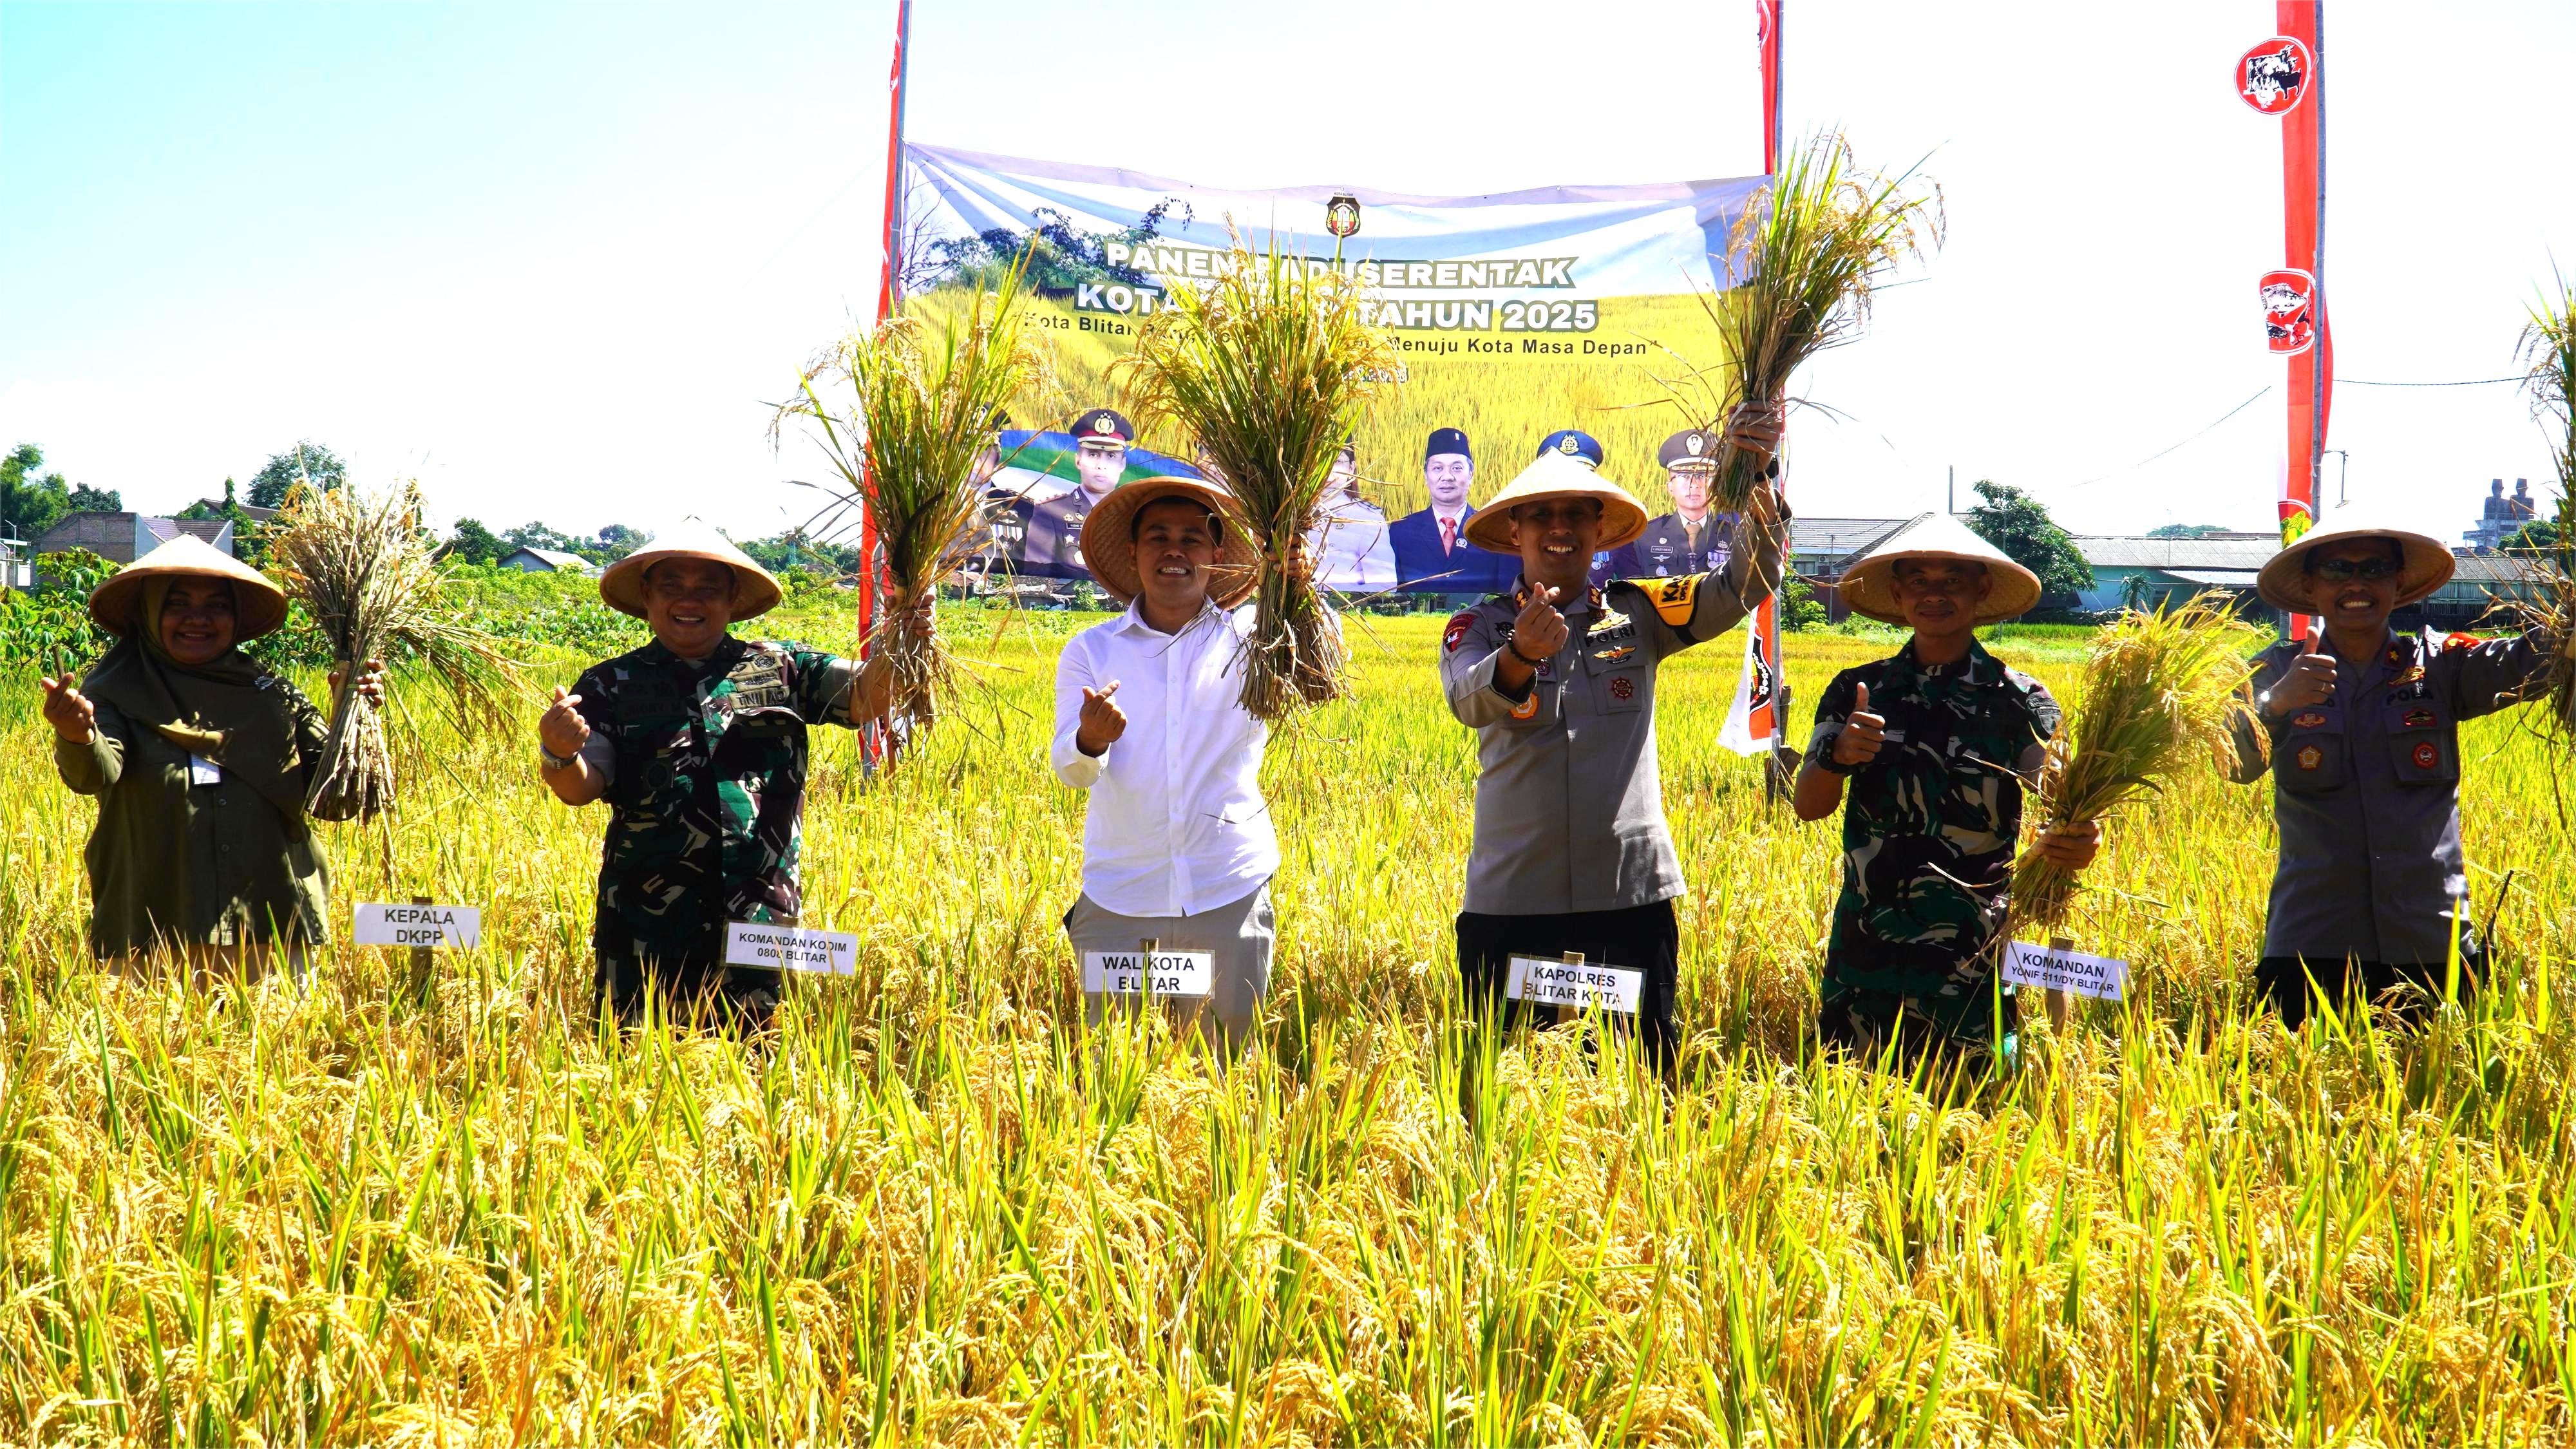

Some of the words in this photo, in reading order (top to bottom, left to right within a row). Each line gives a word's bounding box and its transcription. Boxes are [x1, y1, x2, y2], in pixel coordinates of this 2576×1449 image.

[1106, 242, 1236, 281] PANEN
[1356, 259, 1573, 287] SERENTAK
[1356, 302, 1490, 328] TAHUN
[1504, 303, 1596, 329] 2025
[1467, 338, 1513, 354] Kota
[1522, 339, 1574, 354] Masa
[1584, 624, 1636, 648] POLRI
[384, 909, 455, 925] KEPALA
[396, 929, 443, 944] DKPP
[739, 933, 806, 948] KOMANDAN
[810, 940, 847, 952] KODIM
[786, 950, 827, 963] BLITAR
[2022, 952, 2105, 978] KOMANDAN
[1534, 966, 1616, 987] KAPOLRES
[2011, 966, 2040, 979] YONIF
[2041, 972, 2075, 985] 511/DY
[2077, 978, 2115, 992] BLITAR
[1524, 983, 1577, 1000] BLITAR
